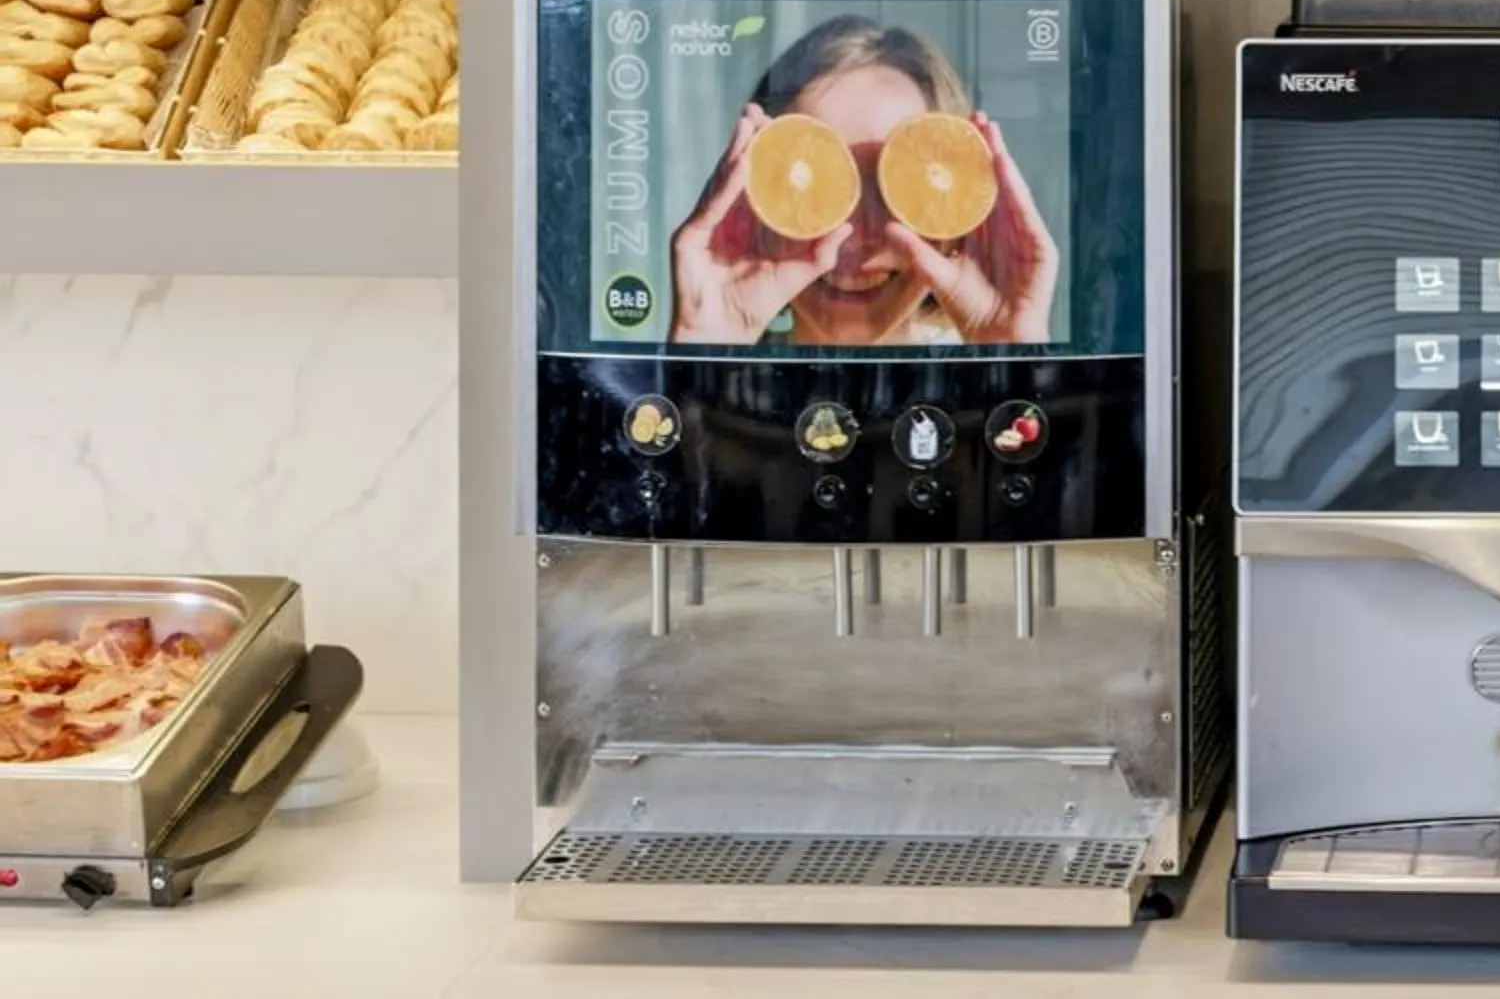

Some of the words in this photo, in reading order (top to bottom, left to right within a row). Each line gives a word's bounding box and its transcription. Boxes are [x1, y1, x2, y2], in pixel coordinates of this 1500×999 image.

[669, 40, 733, 57] natura
[607, 9, 650, 256] ZUMOS
[609, 289, 649, 309] B&B
